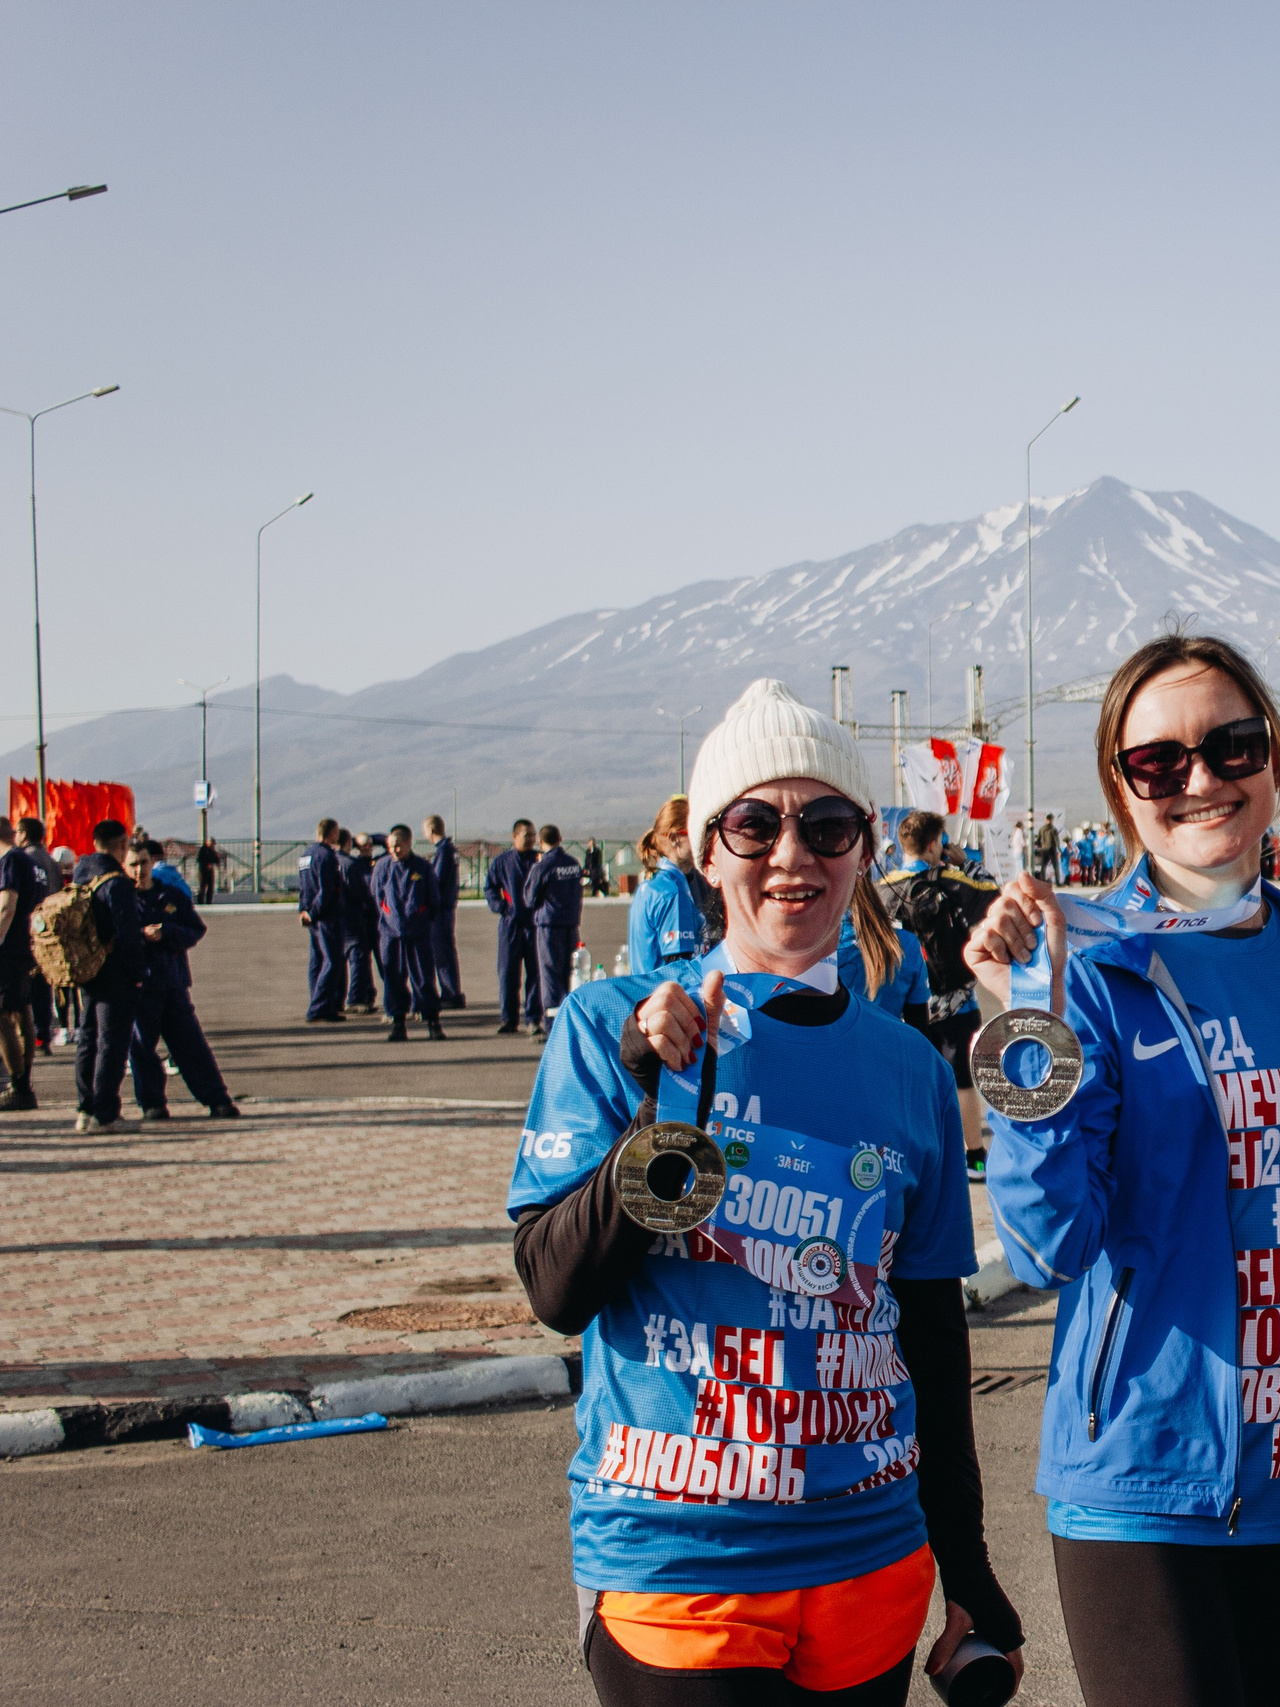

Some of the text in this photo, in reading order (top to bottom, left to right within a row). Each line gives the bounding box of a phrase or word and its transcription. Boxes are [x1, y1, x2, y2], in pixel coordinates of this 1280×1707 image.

[1177, 917, 1210, 928] ПСБ
[1201, 1016, 1256, 1071] 24
[724, 1126, 756, 1143] ПСБ
[724, 1174, 843, 1241] 30051
[796, 1261, 837, 1291] ЛИШНЕМУ ВЕСУ!
[823, 1244, 841, 1274] ВЫЗОВ
[644, 1313, 785, 1387] #ЗАБЕГ
[694, 1379, 898, 1445] #ГОРДОСТЬ
[595, 1422, 807, 1502] #ЛЮБОВЬ
